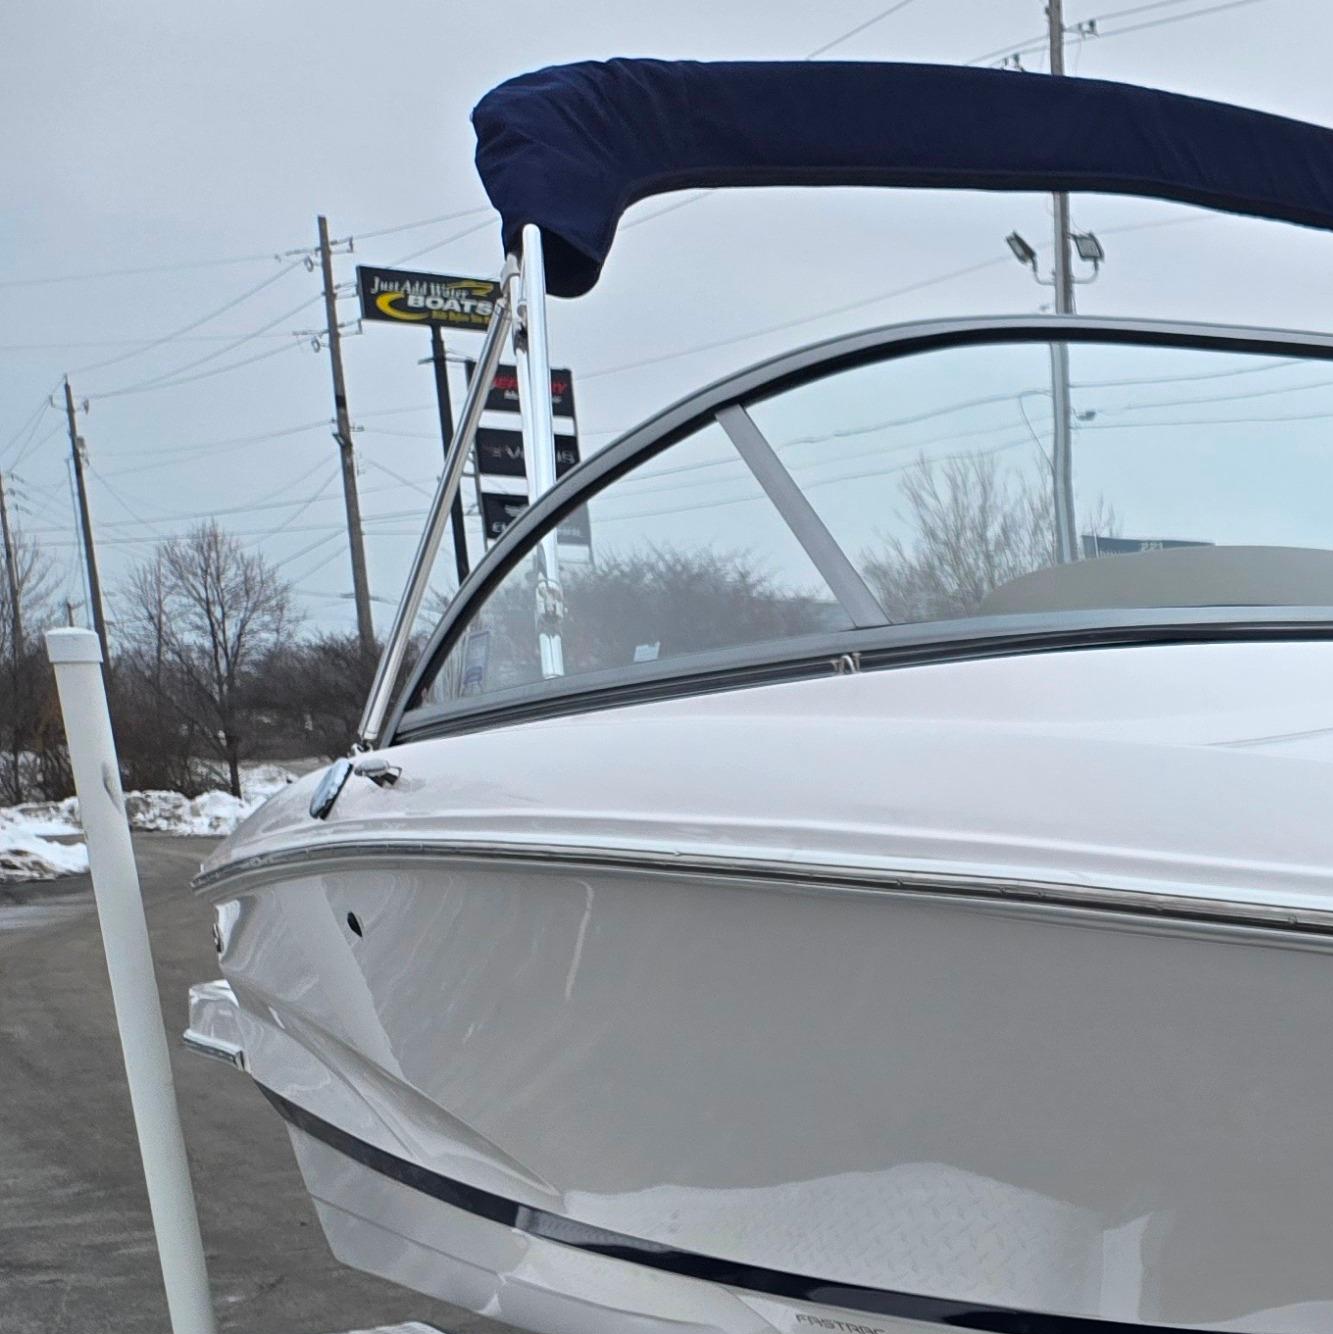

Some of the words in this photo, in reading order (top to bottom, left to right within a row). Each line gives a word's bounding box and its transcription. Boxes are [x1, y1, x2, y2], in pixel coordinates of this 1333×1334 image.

[370, 276, 399, 295] Just
[401, 279, 428, 297] Add
[429, 282, 469, 300] Water
[407, 294, 494, 316] BOATS
